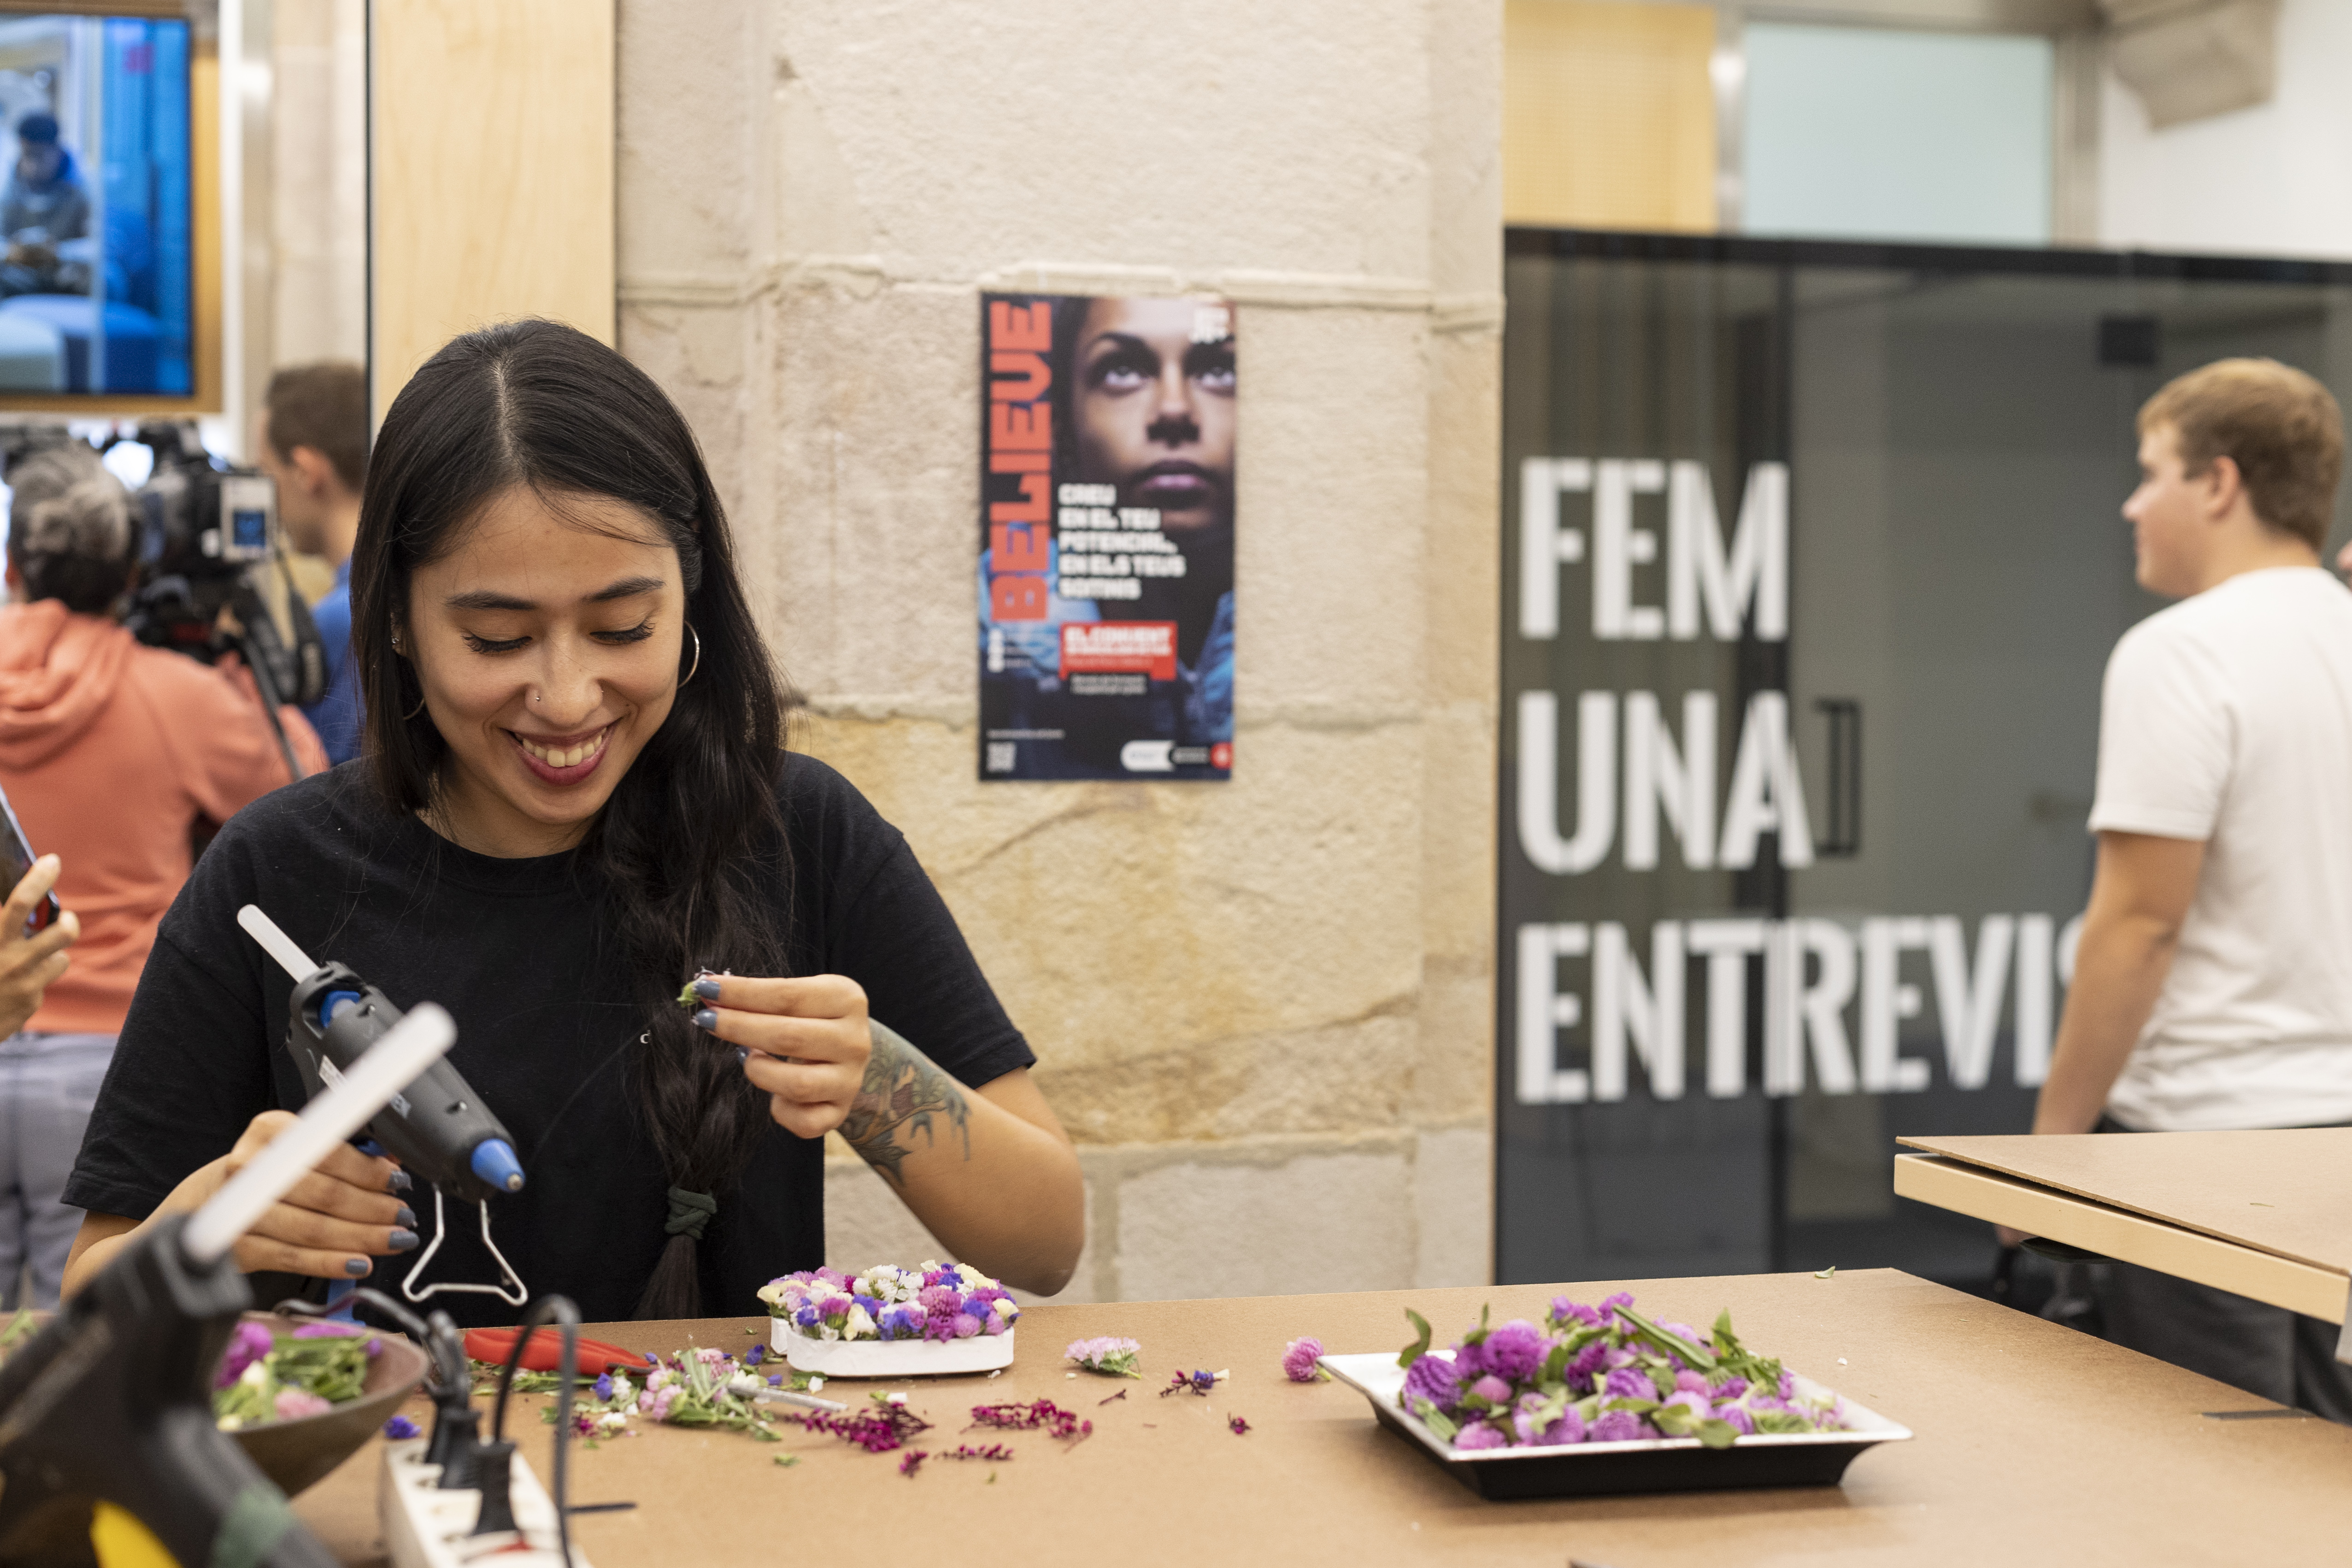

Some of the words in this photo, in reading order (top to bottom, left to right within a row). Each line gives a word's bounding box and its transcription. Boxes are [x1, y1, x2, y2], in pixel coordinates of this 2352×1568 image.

[989, 301, 1051, 622] BELIEVE
[1519, 459, 1790, 640] FEM
[1518, 691, 1816, 874] UNA
[1516, 914, 2085, 1103] ENTREVI
